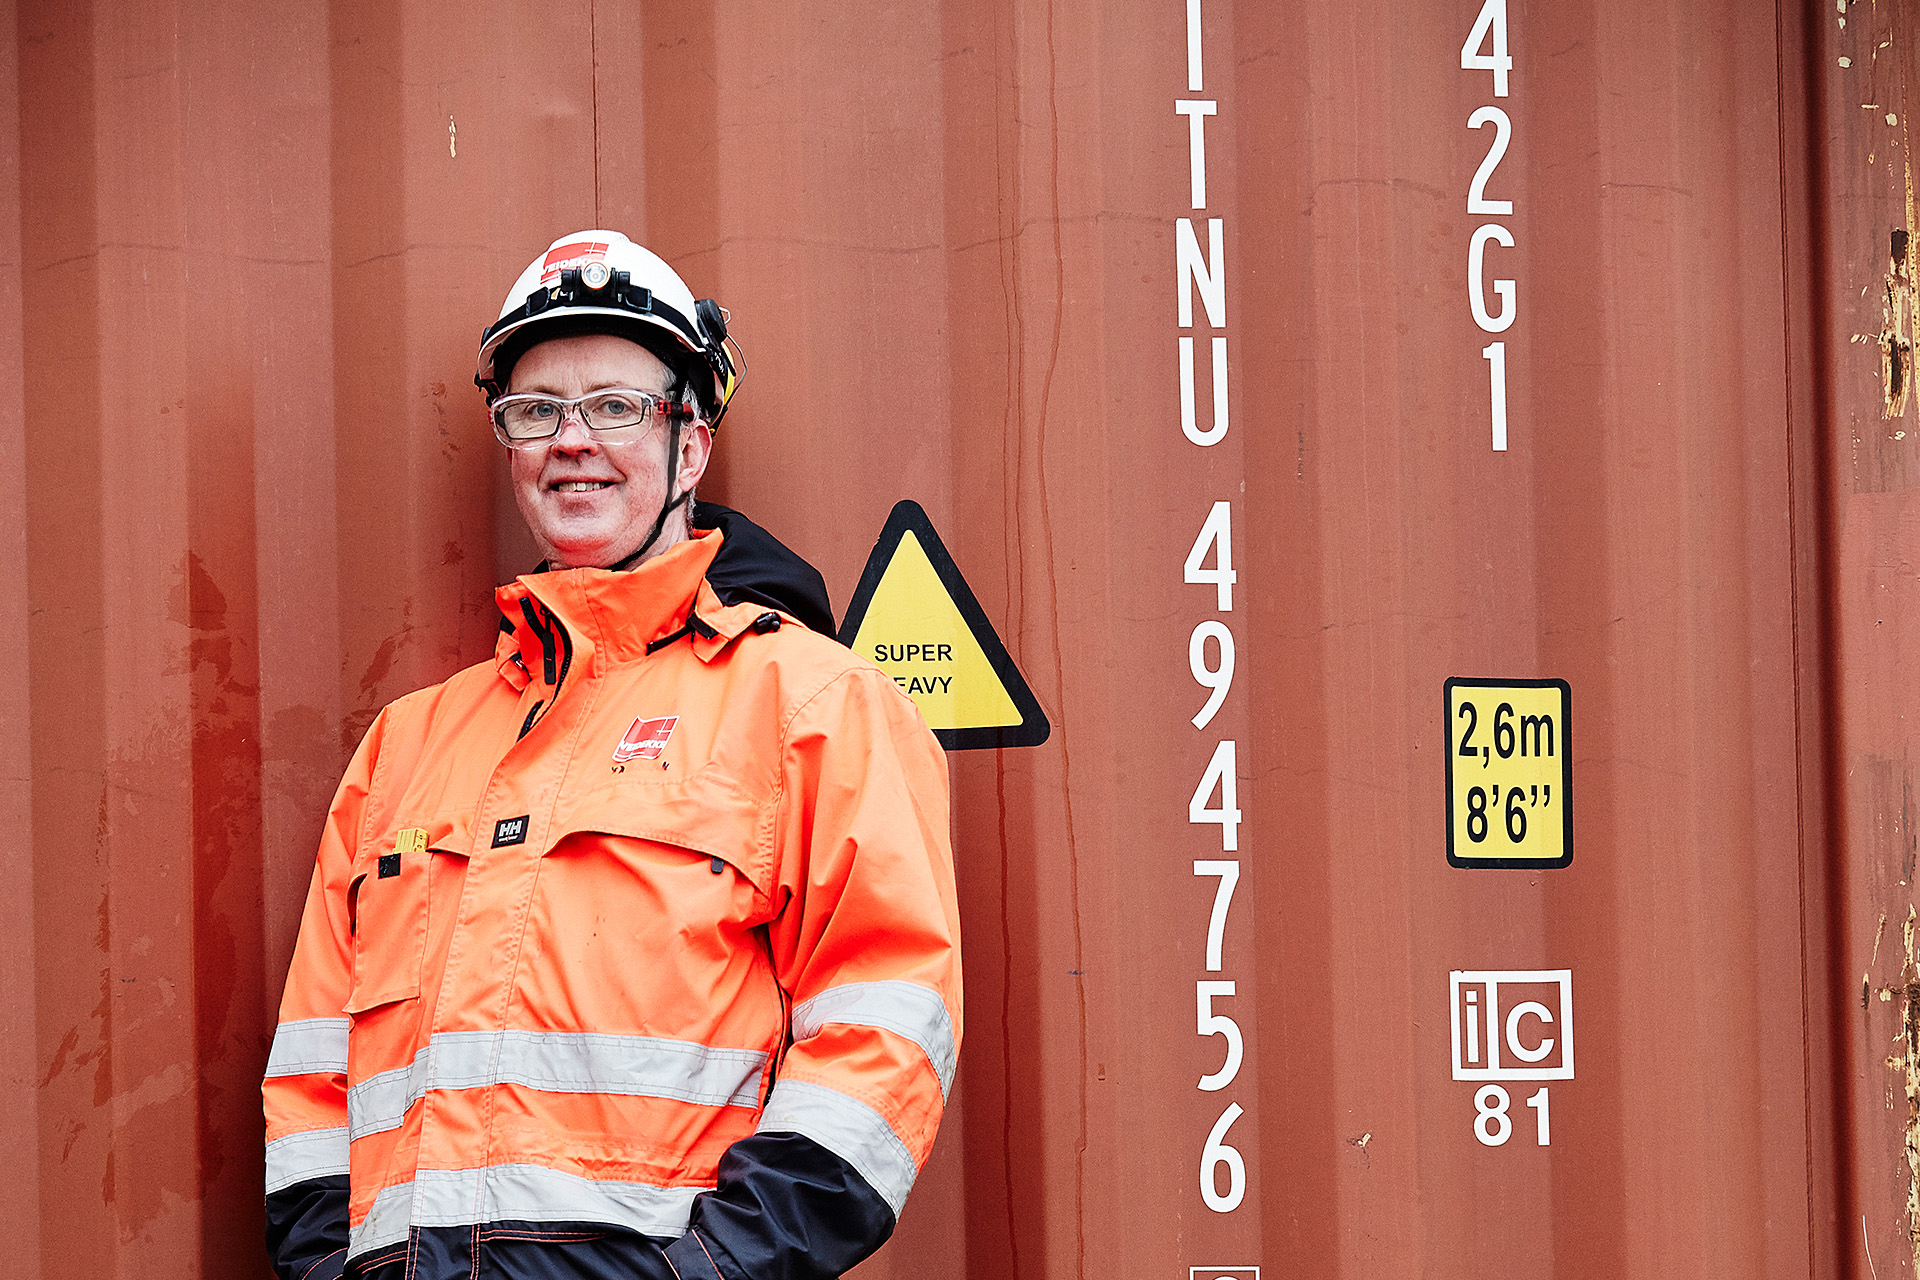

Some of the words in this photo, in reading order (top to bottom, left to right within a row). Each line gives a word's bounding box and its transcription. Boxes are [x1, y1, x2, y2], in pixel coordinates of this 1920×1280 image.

[1460, 0, 1517, 451] 42G1
[543, 257, 593, 275] VEIDEK
[874, 644, 953, 662] SUPER
[893, 676, 953, 695] AVY
[1458, 701, 1554, 769] 2,6m
[498, 820, 523, 837] HH
[1183, 500, 1247, 1213] 494756
[1472, 1083, 1551, 1147] 81
